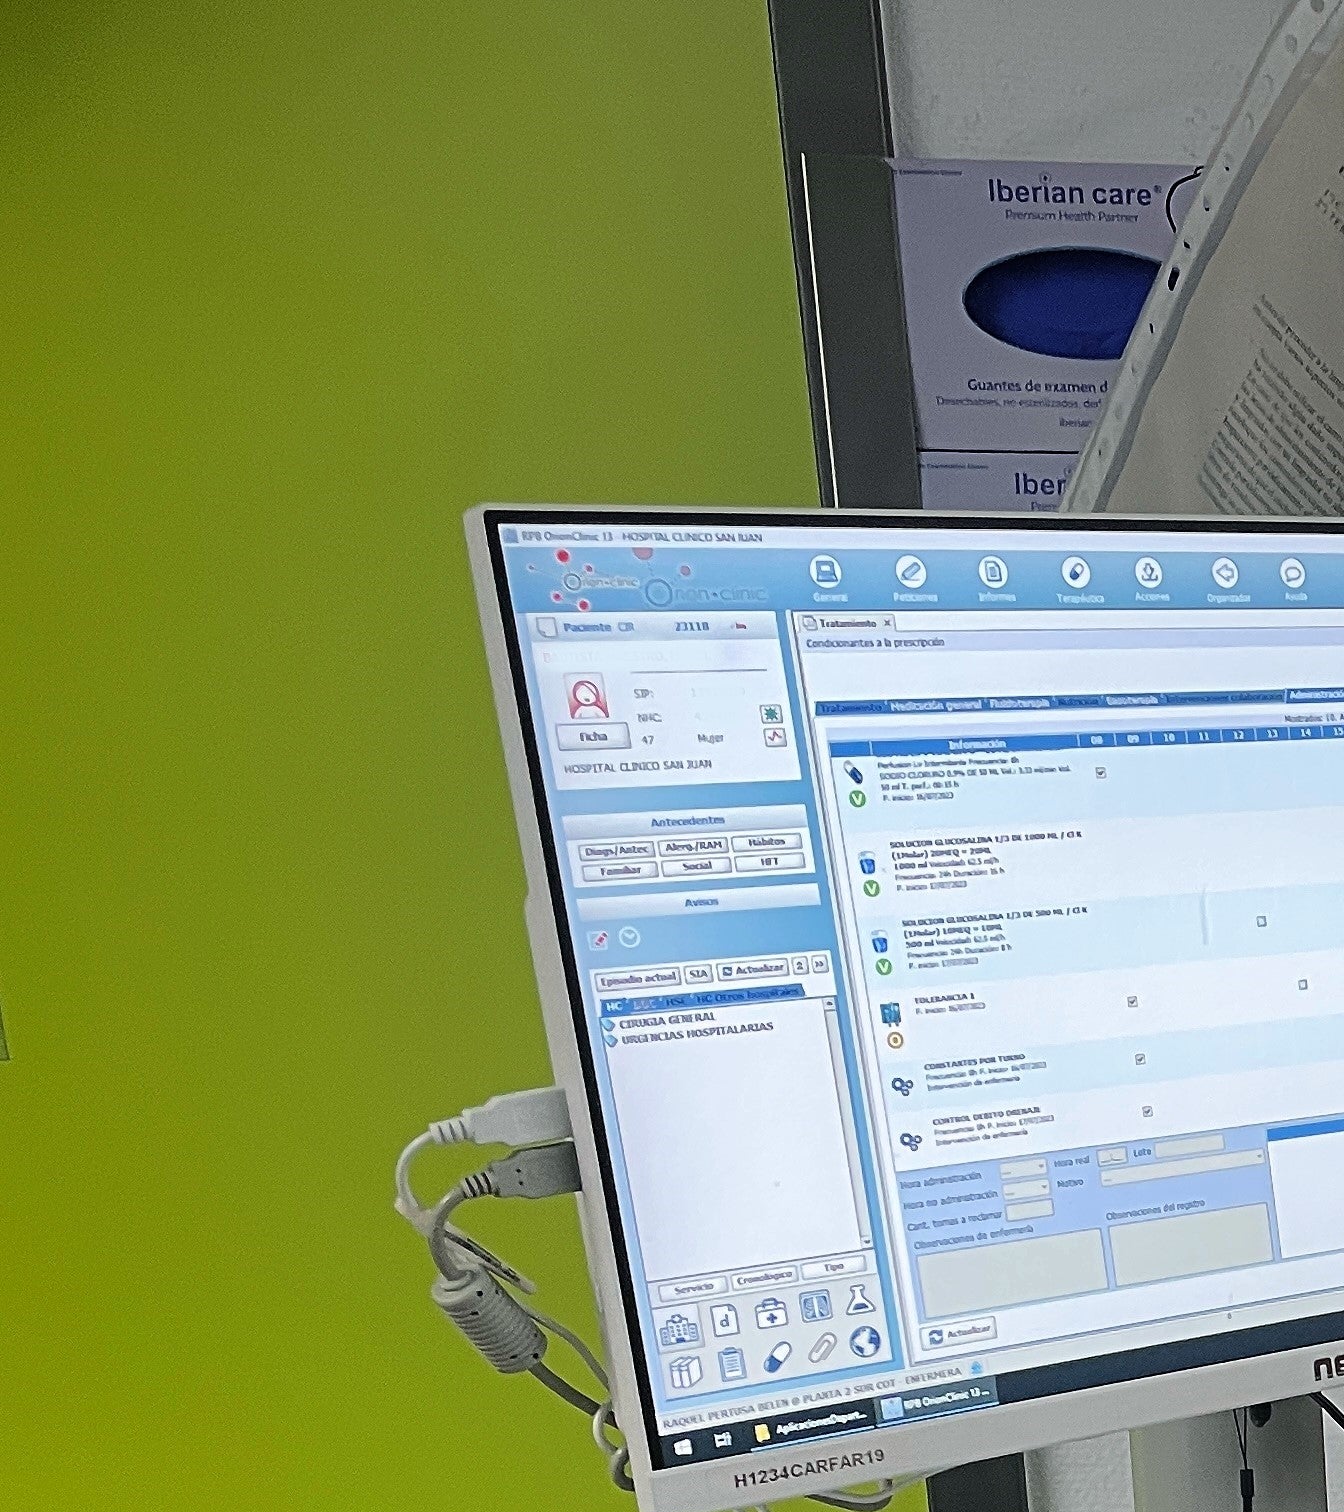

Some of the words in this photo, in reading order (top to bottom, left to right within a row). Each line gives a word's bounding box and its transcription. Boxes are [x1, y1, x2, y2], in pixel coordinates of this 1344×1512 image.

[989, 175, 1084, 205] Iberian
[968, 379, 1021, 393] Guantes
[1025, 379, 1042, 392] de
[1045, 381, 1095, 393] examen
[622, 531, 670, 542] HOSPITAL
[671, 532, 713, 542] CLINICO
[715, 532, 735, 542] SAN
[737, 532, 763, 542] JUAN
[563, 621, 612, 633] Paciente
[819, 618, 876, 629] Tratamiento
[806, 638, 873, 650] Condicionantes
[579, 730, 607, 742] Ficha
[641, 735, 654, 746] 47
[948, 738, 1007, 751] Información
[564, 763, 616, 776] HOSPITAL
[618, 760, 660, 773] CLINICO
[662, 759, 684, 771] SAN
[686, 758, 712, 770] JUAN
[650, 814, 725, 829] Antecedentes
[682, 860, 712, 872] Social
[644, 971, 676, 983] actual
[606, 1001, 623, 1012] HC
[620, 1015, 666, 1030] CIRUGIA
[668, 1010, 716, 1025] GENERAL
[622, 1030, 684, 1045] URGENCIAS
[686, 1020, 774, 1039] HOSPITALARIAS
[923, 1170, 981, 1188] administración
[1133, 1147, 1151, 1158] Lote
[940, 1188, 998, 1207] administración
[674, 1280, 714, 1297] Servicio
[824, 1261, 844, 1274] Tipo
[947, 1322, 990, 1340] Actualizar
[734, 1447, 886, 1490] H1234CARFAR19
